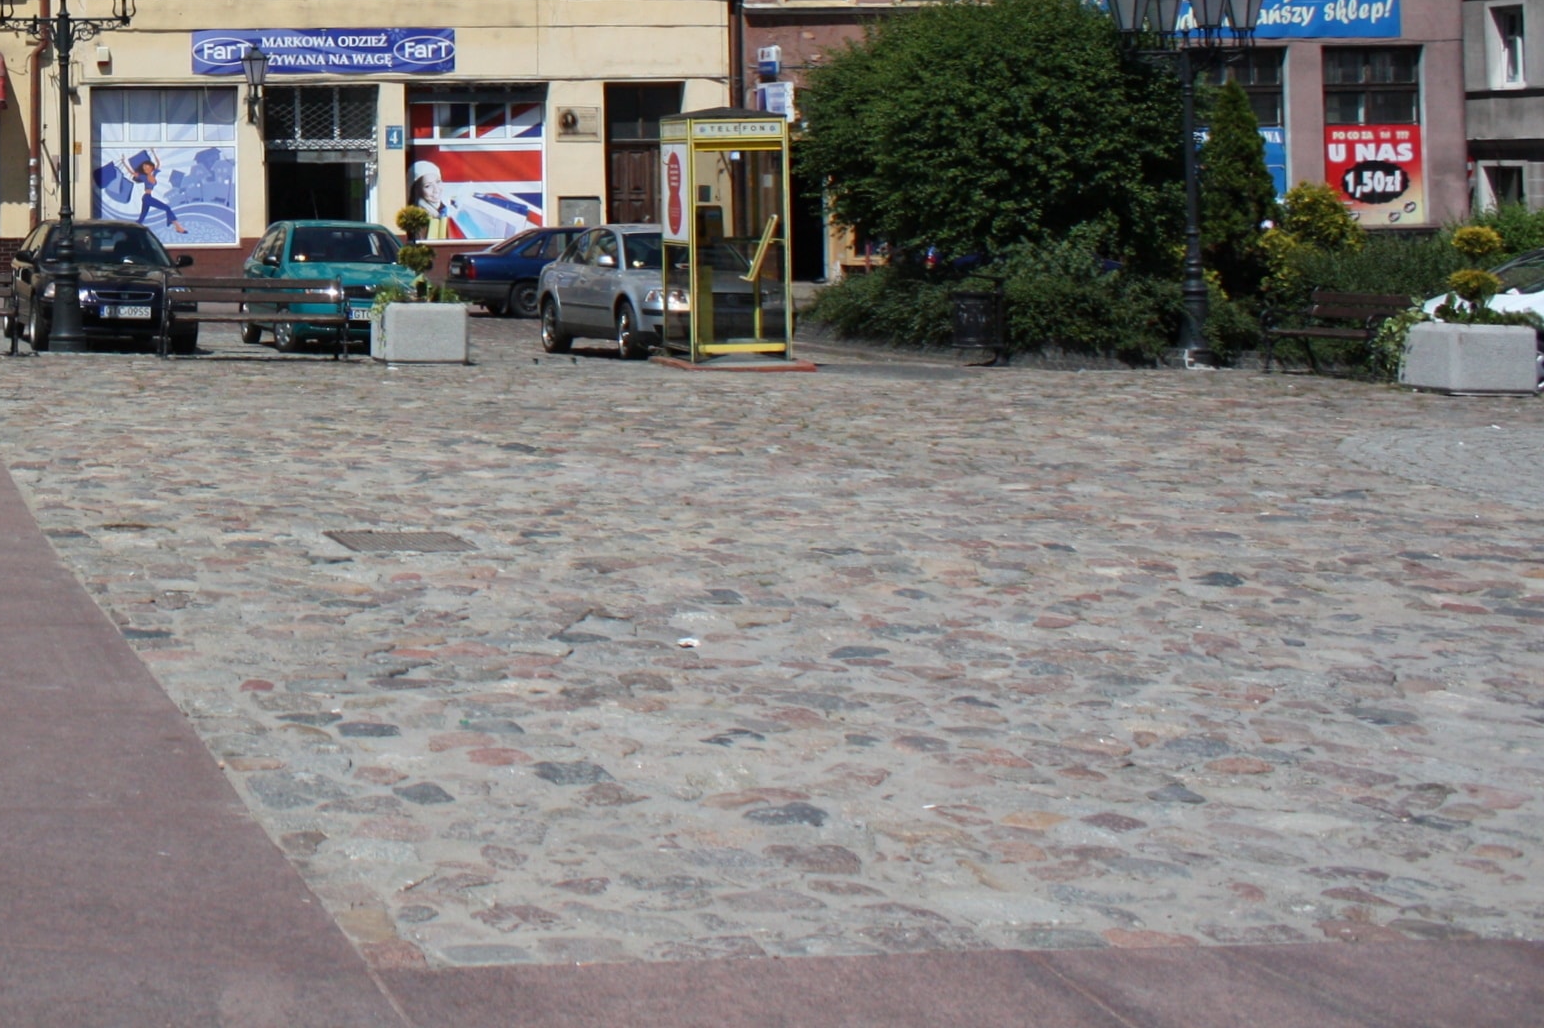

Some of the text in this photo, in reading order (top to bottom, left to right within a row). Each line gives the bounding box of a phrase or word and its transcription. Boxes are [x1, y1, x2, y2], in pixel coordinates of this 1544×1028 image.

[1257, 3, 1315, 27] ańszy
[261, 32, 388, 48] MARKOWA ODZIEŻ
[203, 43, 250, 60] FarT
[404, 41, 450, 58] FarT
[266, 52, 393, 68] ŻYWANA NA WAGĘ
[388, 130, 399, 144] 4
[710, 125, 766, 133] TELEFON
[1327, 142, 1414, 163] U NAS
[1344, 169, 1403, 199] 1,50zł
